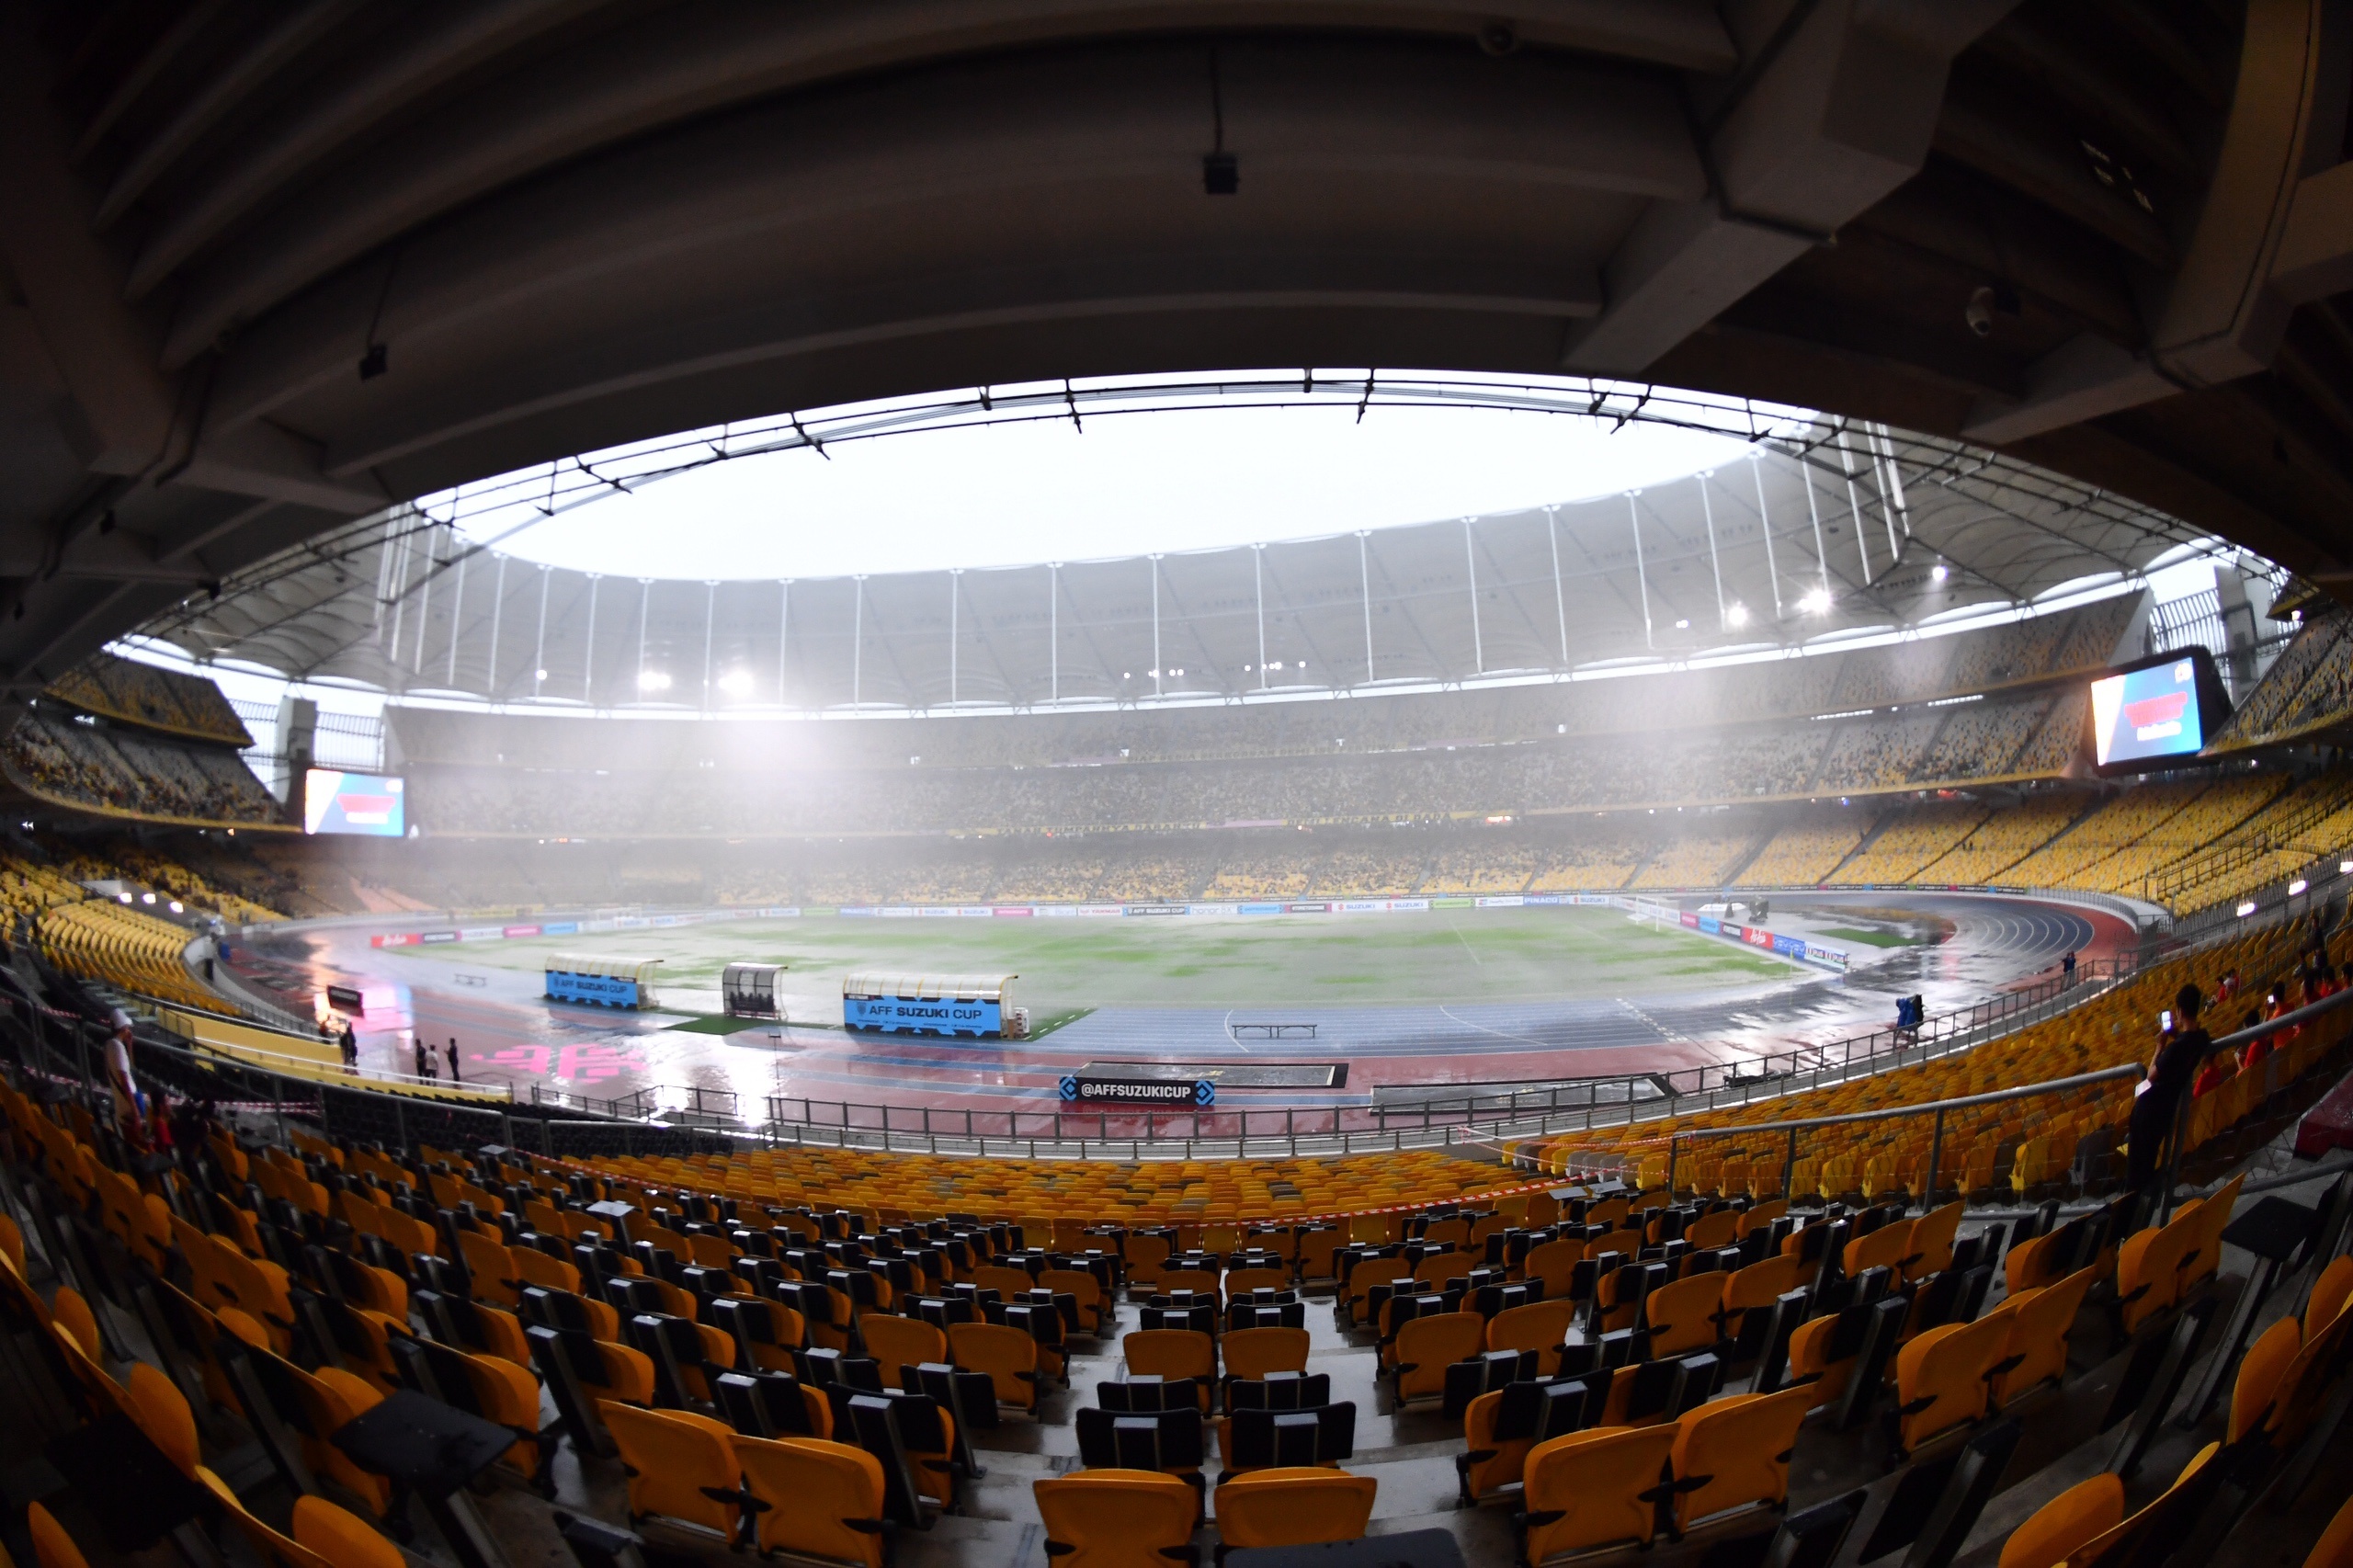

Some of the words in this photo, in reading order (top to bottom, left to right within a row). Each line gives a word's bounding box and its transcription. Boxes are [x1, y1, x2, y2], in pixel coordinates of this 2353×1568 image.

[870, 1006, 892, 1015] AFF
[897, 1007, 949, 1017] SUZUKI
[953, 1009, 982, 1019] CUP
[1081, 1084, 1191, 1098] @AFFSUZUKICUP
